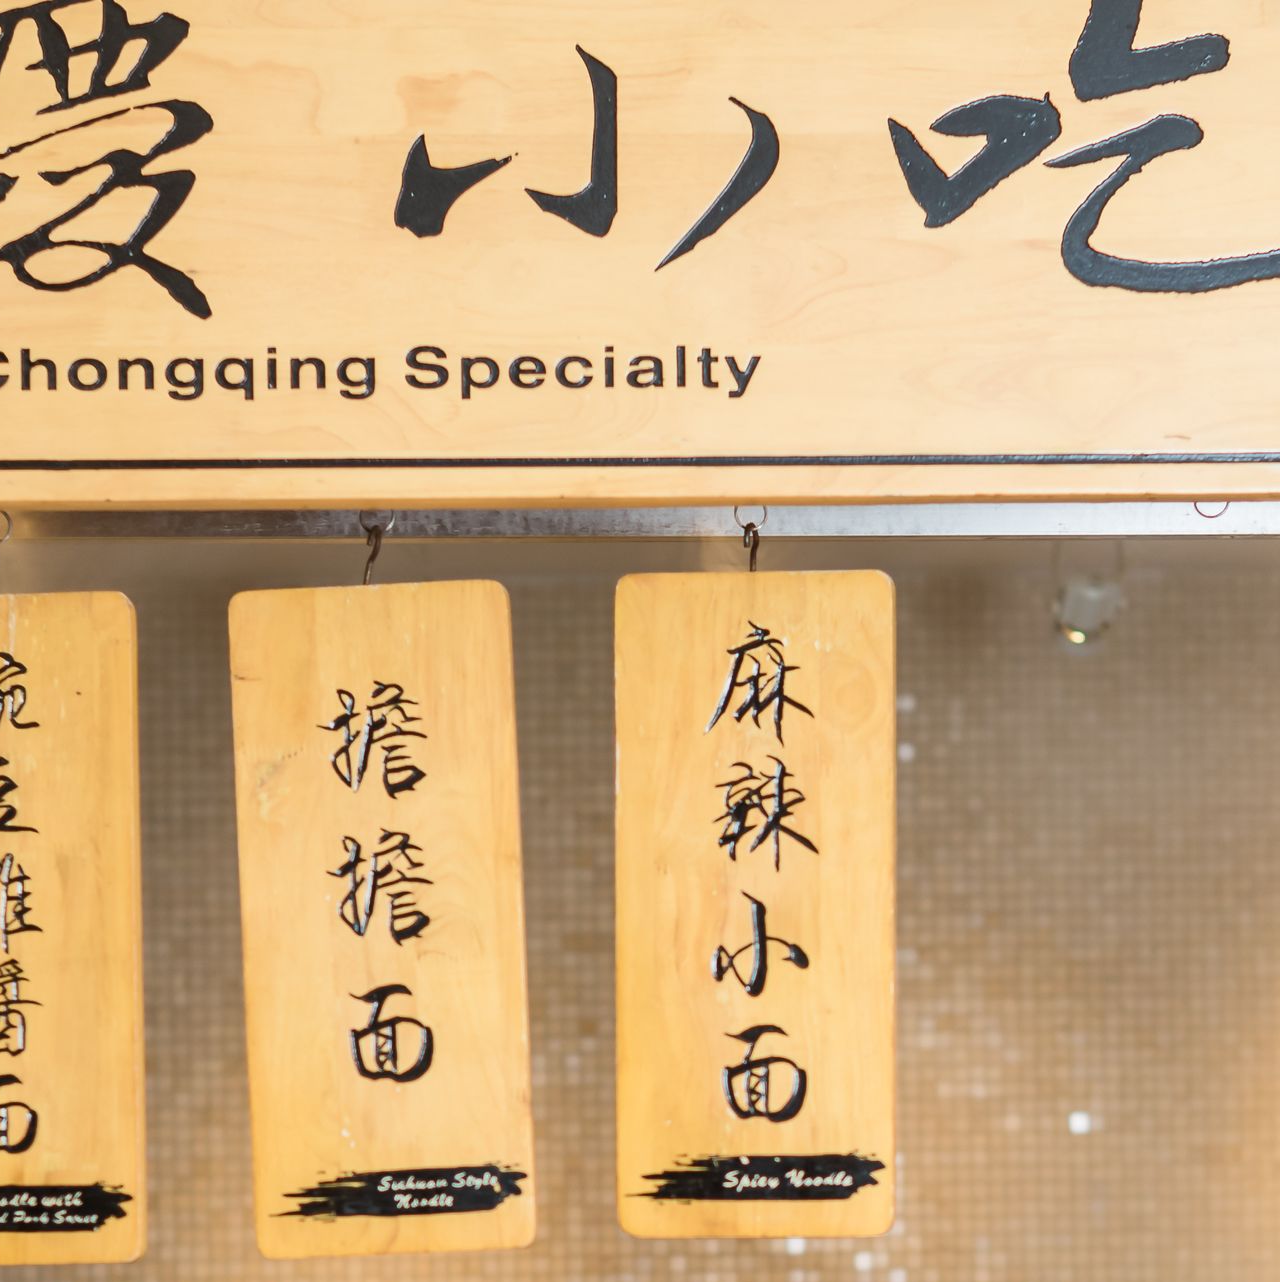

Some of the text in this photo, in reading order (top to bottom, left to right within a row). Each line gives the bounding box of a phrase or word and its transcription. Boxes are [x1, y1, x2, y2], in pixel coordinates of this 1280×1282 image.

[404, 344, 761, 399] Specialty
[317, 680, 434, 1083] 擔擔面
[705, 620, 819, 1123] 麻辣小面
[451, 1170, 499, 1191] Style
[722, 1169, 854, 1193] Spicy Noodle
[41, 1191, 83, 1208] with
[393, 1193, 455, 1209] Noodle
[53, 1209, 99, 1225] Sauce
